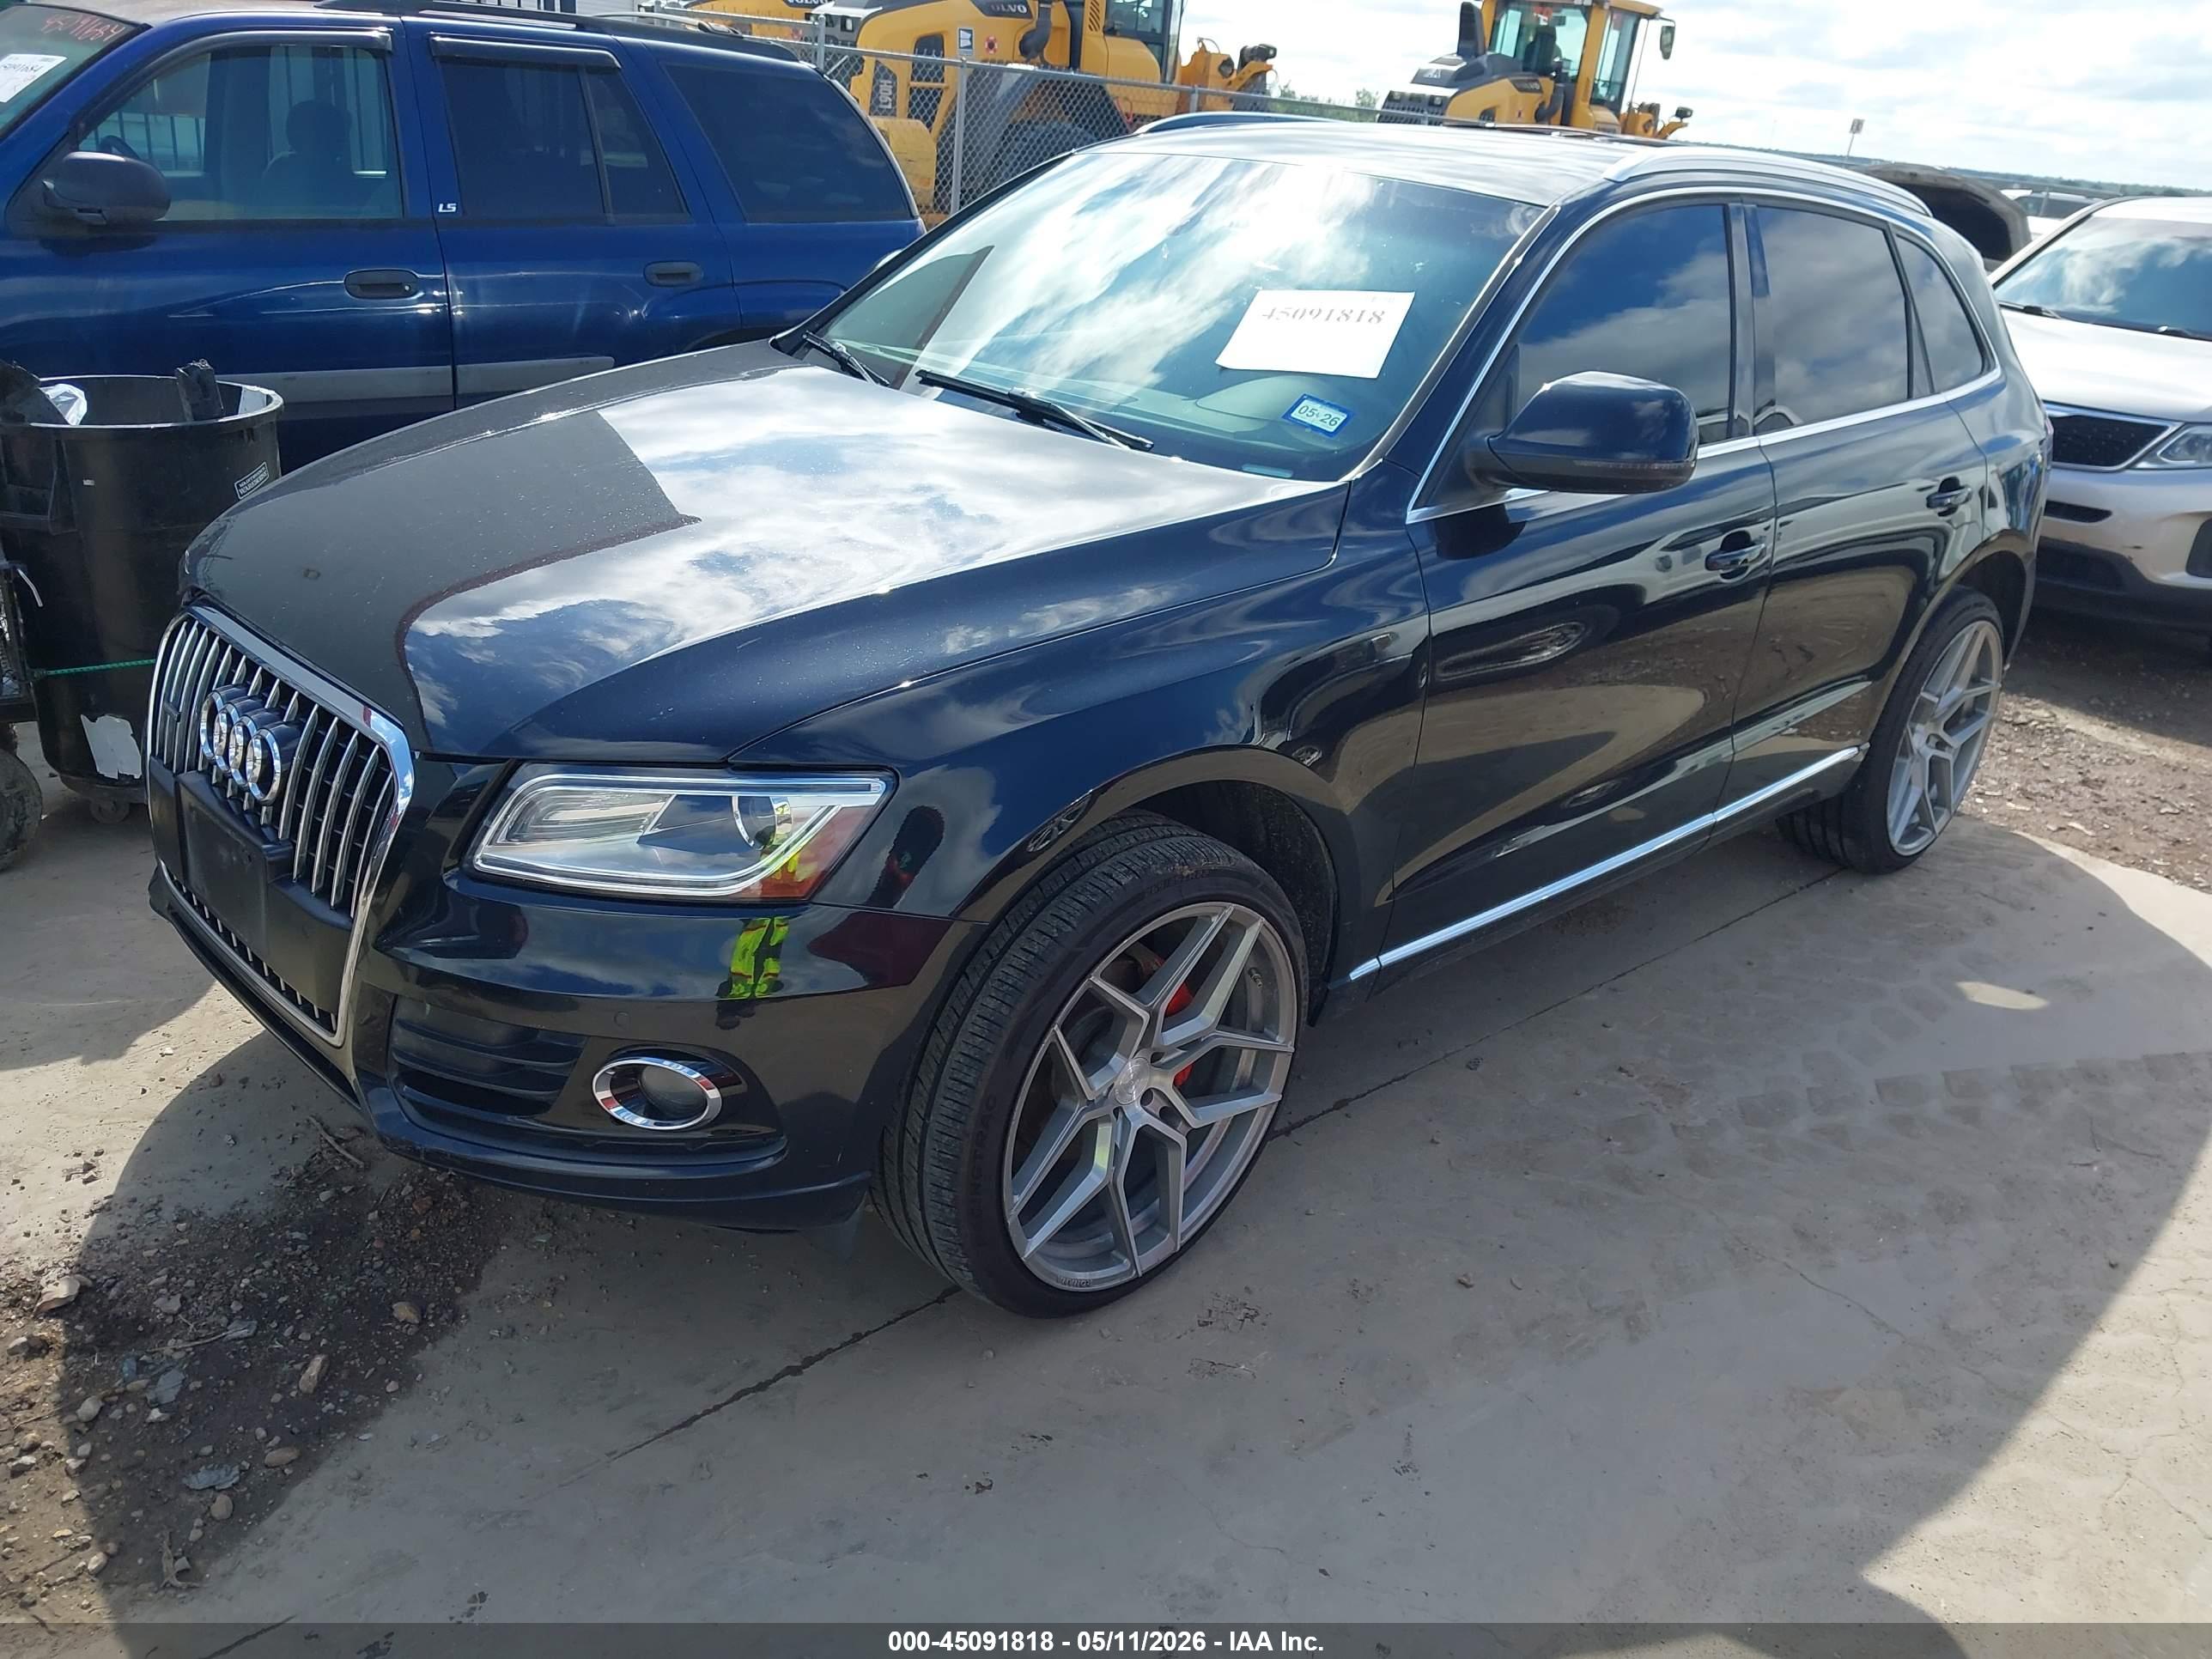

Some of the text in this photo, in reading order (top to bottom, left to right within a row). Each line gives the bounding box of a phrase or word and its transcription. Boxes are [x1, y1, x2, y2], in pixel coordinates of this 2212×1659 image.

[878, 79, 893, 109] L90H
[438, 203, 457, 213] LS
[1261, 307, 1386, 324] 45091818
